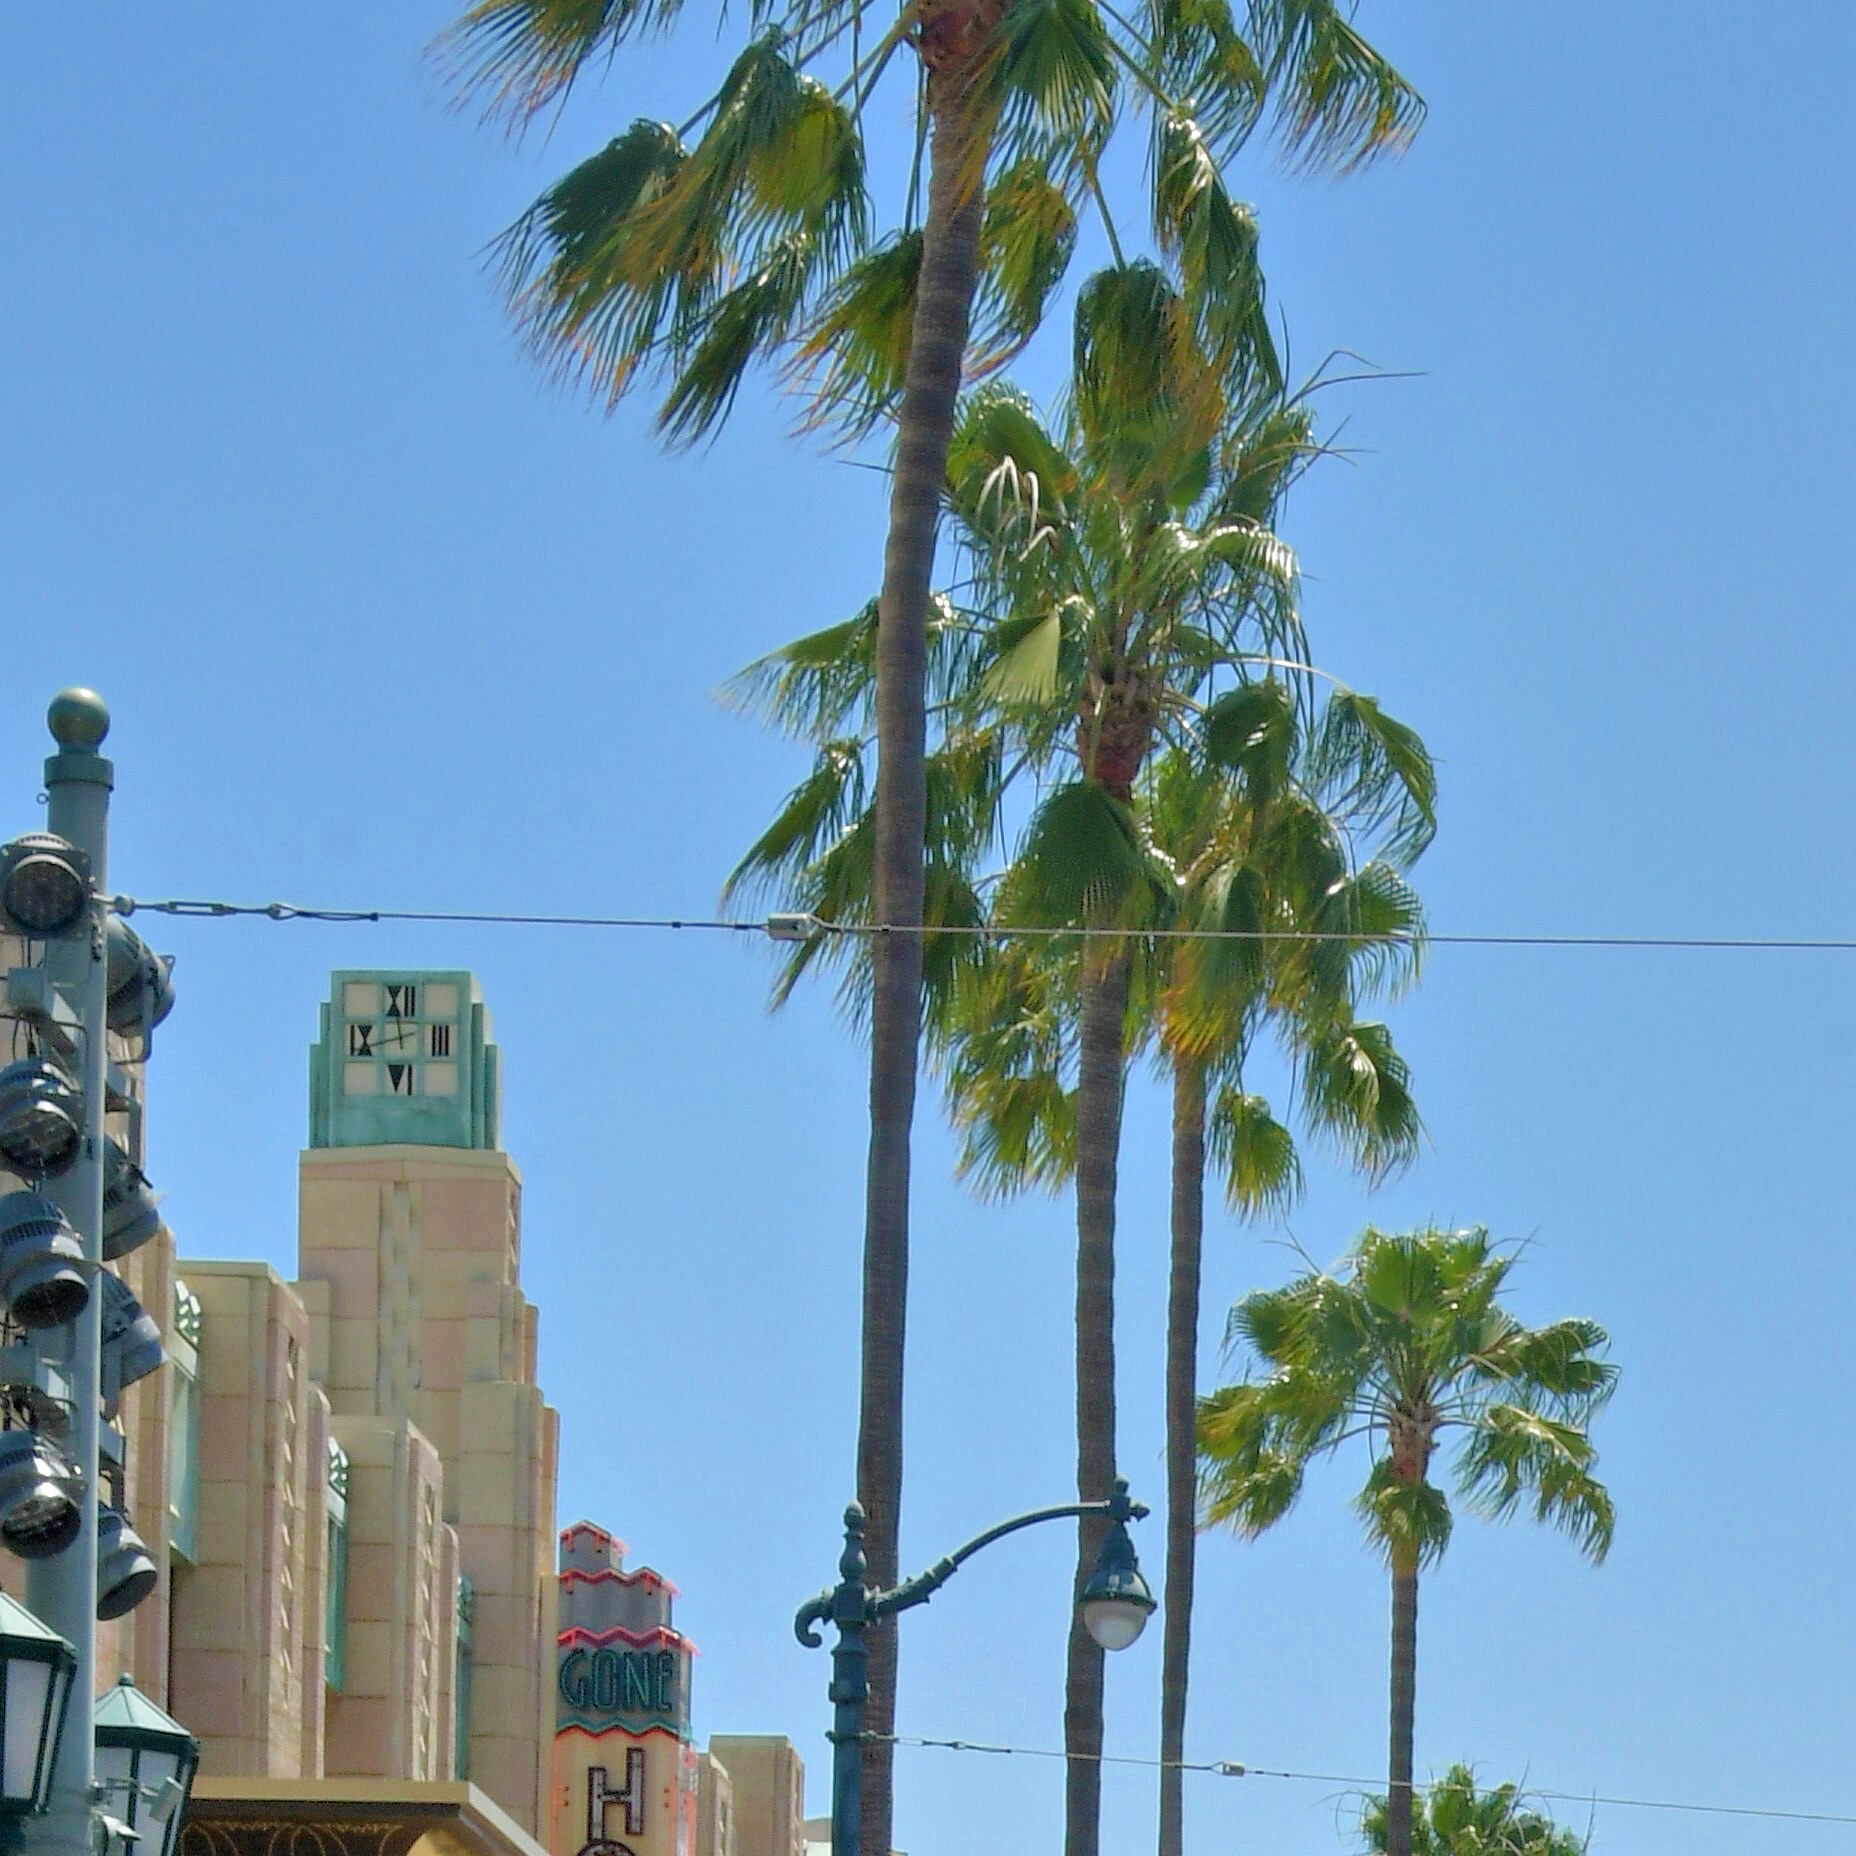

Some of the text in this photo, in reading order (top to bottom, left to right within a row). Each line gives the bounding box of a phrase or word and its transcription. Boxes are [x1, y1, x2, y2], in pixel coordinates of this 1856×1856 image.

[386, 985, 416, 1017] XII
[388, 1064, 413, 1096] VI
[559, 1649, 674, 1713] GONE
